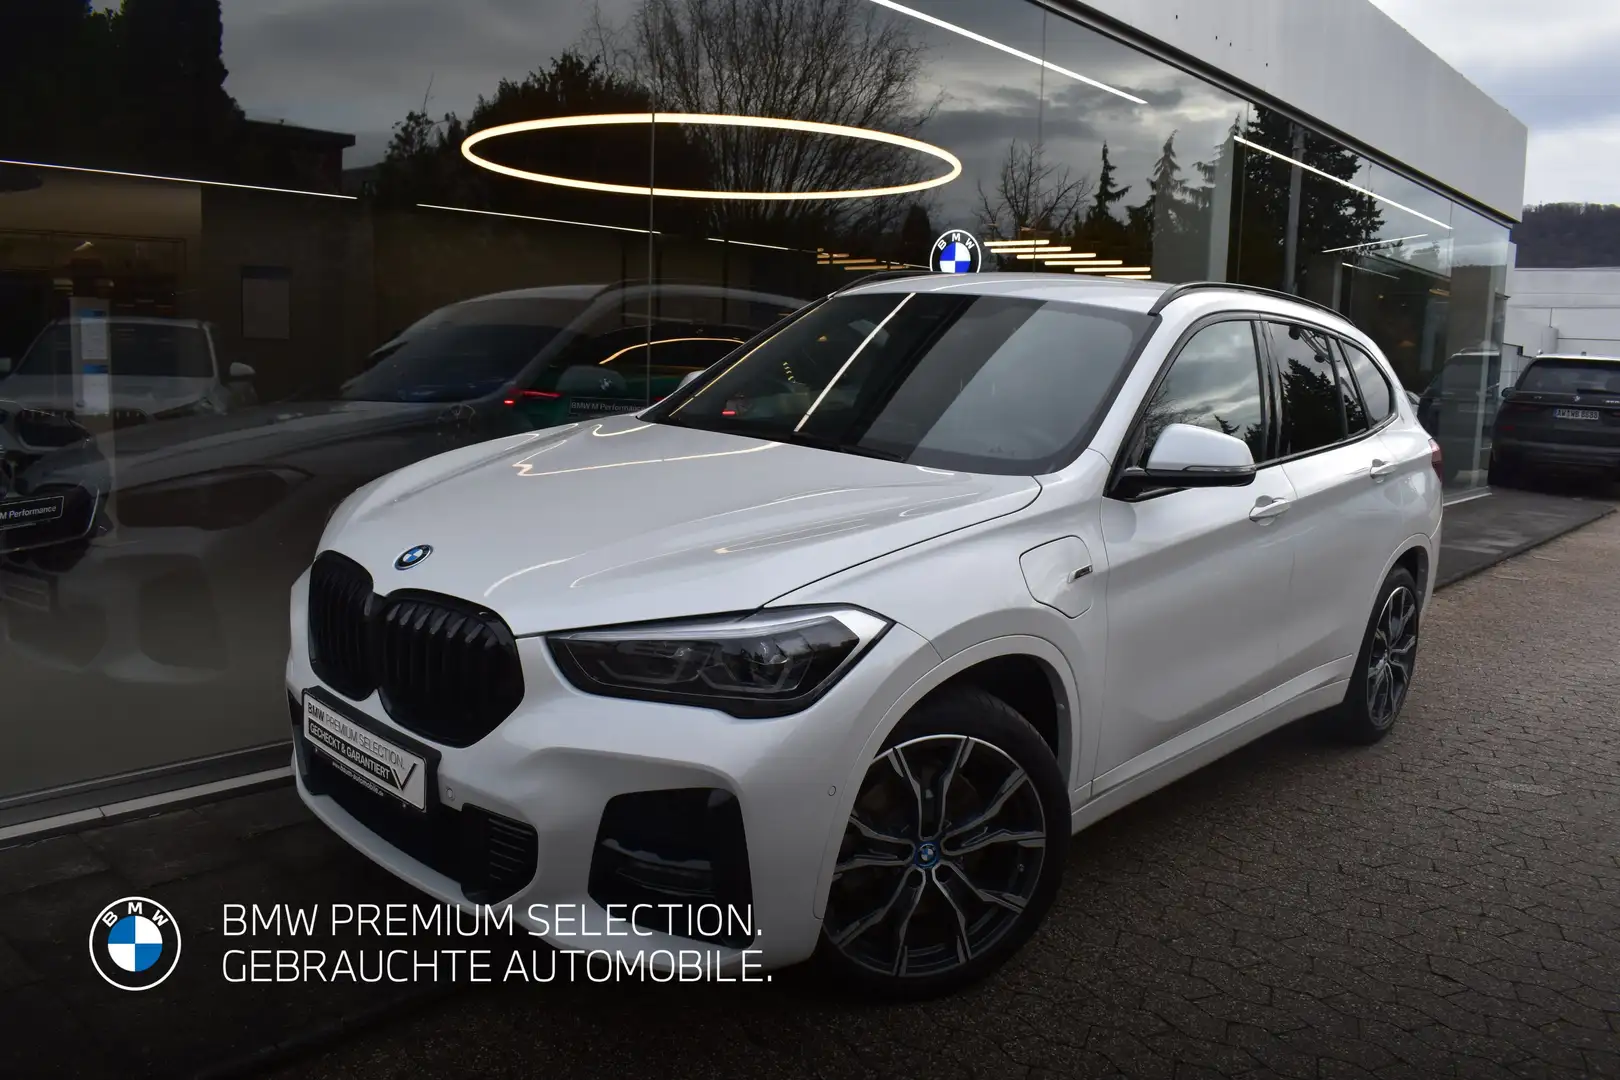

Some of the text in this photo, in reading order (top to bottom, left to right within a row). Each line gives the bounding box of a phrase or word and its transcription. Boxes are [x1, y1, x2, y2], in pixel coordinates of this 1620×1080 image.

[937, 232, 975, 251] BMW
[571, 401, 646, 412] BMW M Performance
[9, 504, 57, 519] Performance
[307, 702, 405, 769] BMW PREMIUM SELECTION.
[309, 722, 391, 780] GECHECKT & GARANTIERT
